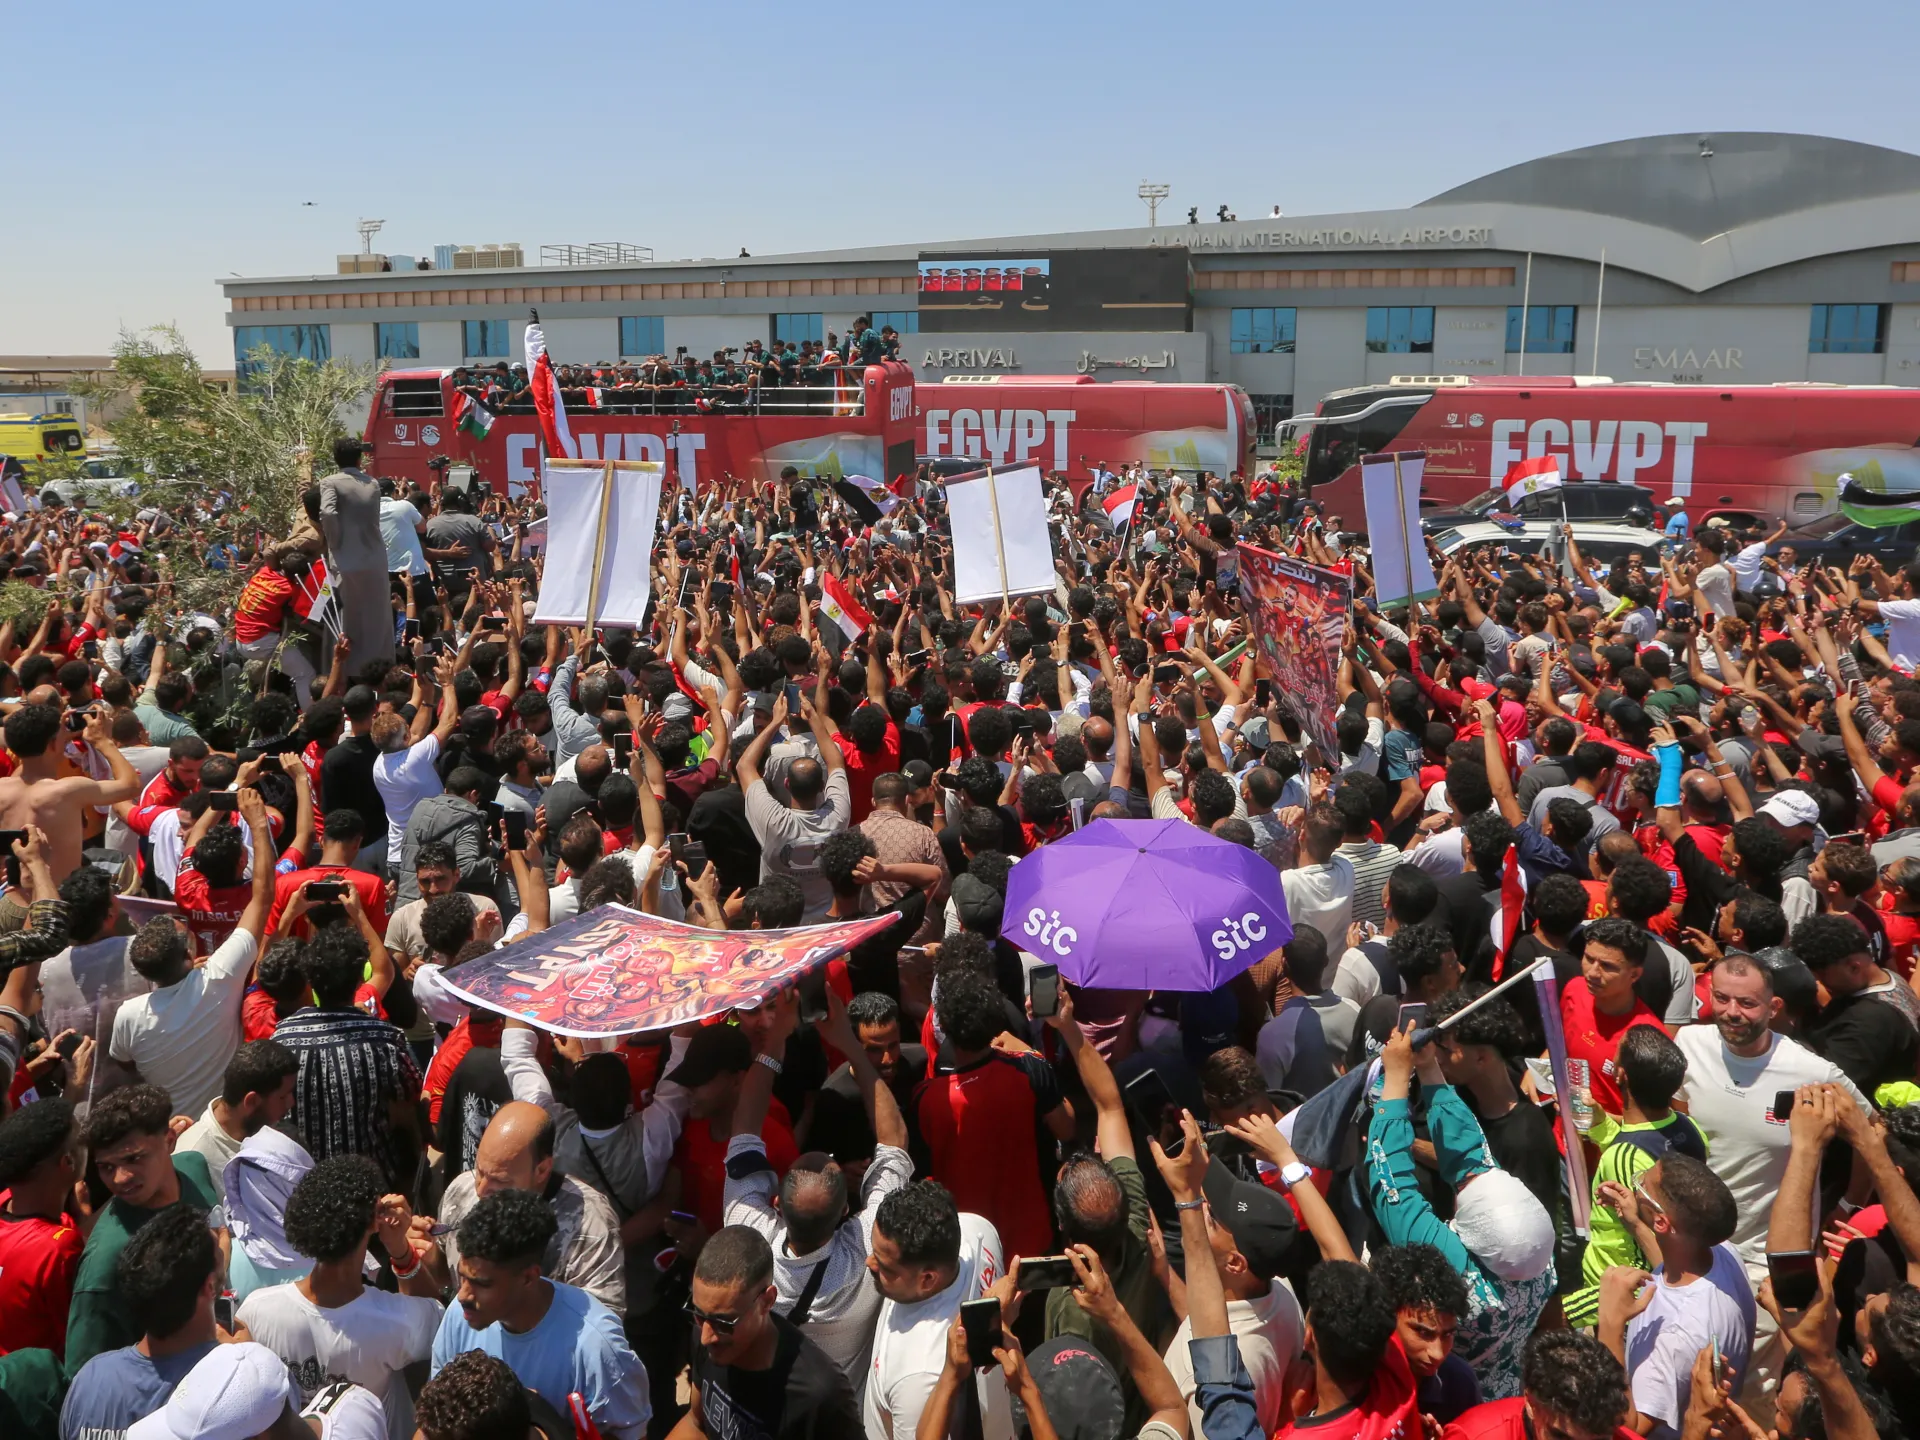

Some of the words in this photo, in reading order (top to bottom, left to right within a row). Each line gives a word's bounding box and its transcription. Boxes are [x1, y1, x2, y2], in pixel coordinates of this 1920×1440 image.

[1239, 228, 1395, 248] INTERNATIONAL
[1400, 225, 1493, 244] AIRPORT
[922, 348, 1022, 369] ARRIVAL
[1634, 347, 1744, 369] EMAAR
[890, 385, 912, 422] EGYPT
[926, 408, 1076, 471] EGYPT
[1023, 907, 1077, 956] stc
[1211, 912, 1267, 960] stc
